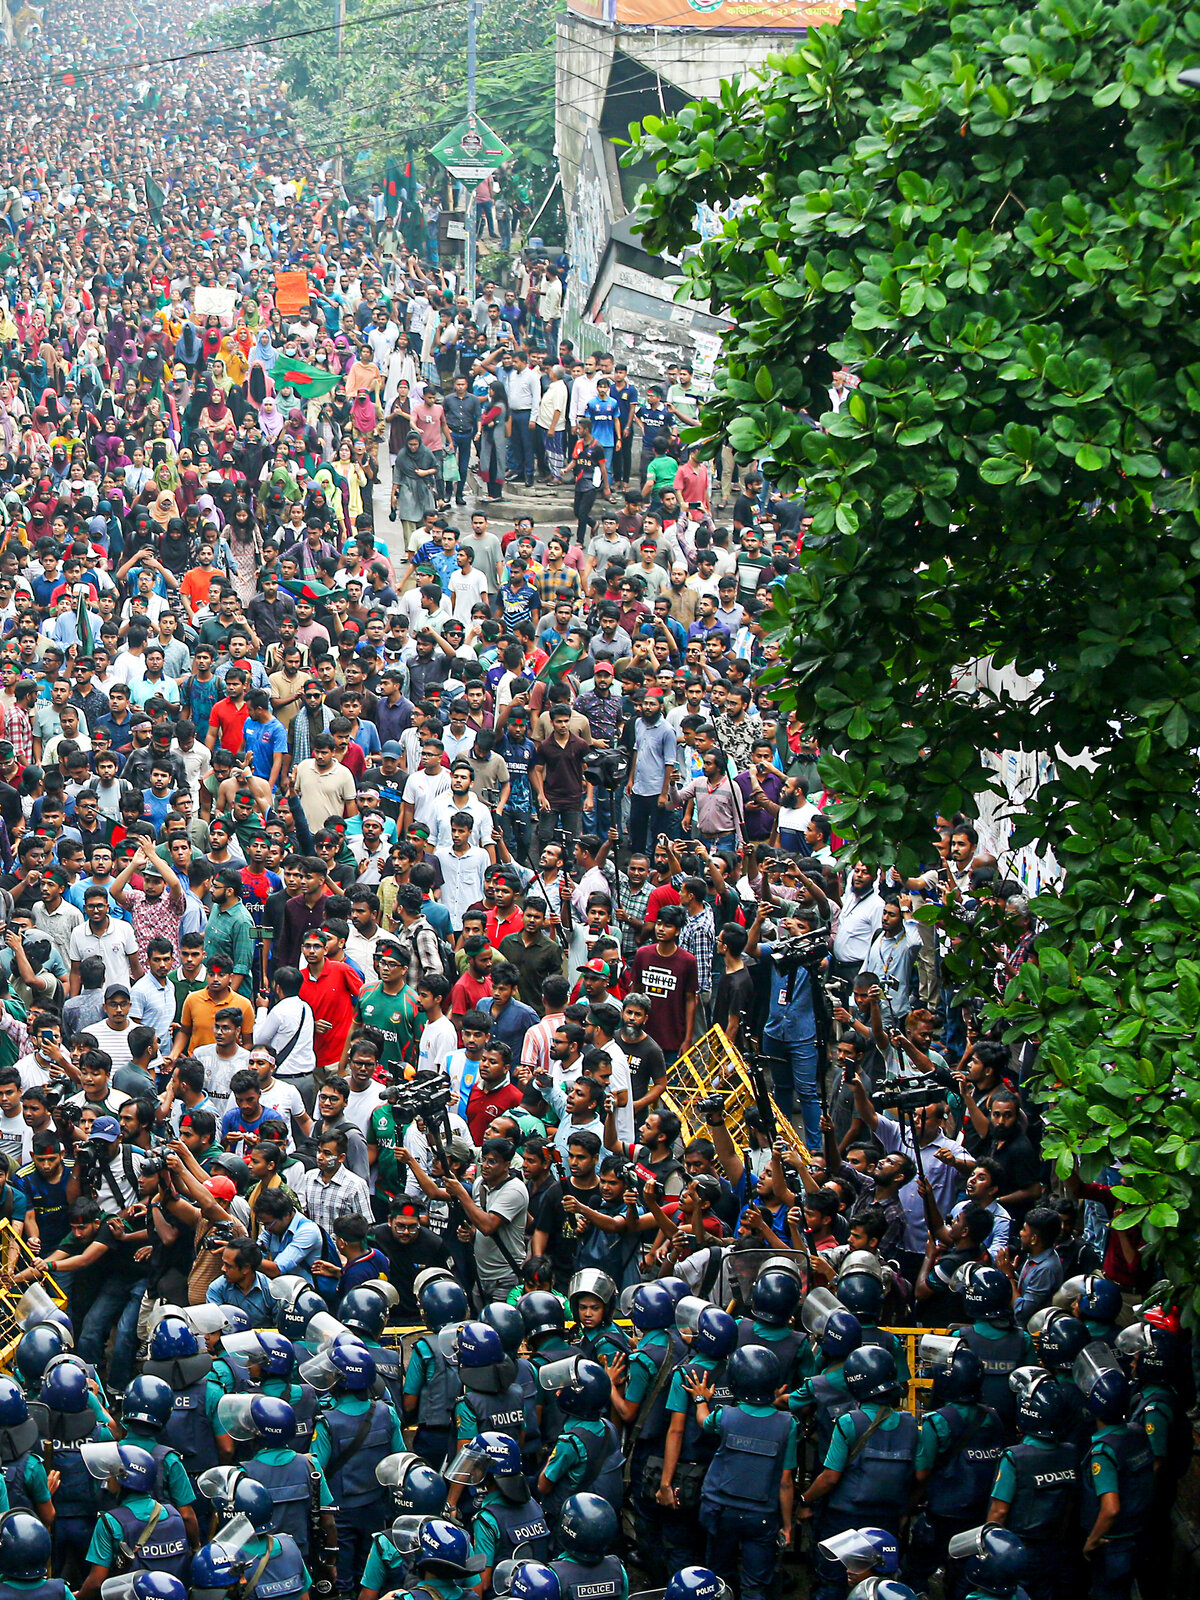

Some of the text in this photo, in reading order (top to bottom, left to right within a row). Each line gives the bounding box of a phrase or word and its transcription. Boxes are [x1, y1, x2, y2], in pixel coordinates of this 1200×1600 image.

[634, 1304, 644, 1312] POLICE
[232, 1316, 247, 1324] POLICE
[286, 1315, 304, 1323] POLICE
[703, 1329, 716, 1340] POLICE
[828, 1329, 842, 1340] POLICE
[462, 1342, 475, 1350] POLICE
[272, 1350, 287, 1359] POLICE
[1144, 1358, 1163, 1367] POLICE
[377, 1364, 399, 1373] POLIC
[848, 1374, 863, 1382] POLICE
[713, 1389, 730, 1397] OLIC
[492, 1410, 524, 1425] POLICE
[1021, 1408, 1038, 1418] POLICE
[486, 1446, 509, 1454] POLICE
[130, 1463, 146, 1473] POLICE
[1034, 1469, 1075, 1486] POLICE
[395, 1499, 413, 1508] POLICE
[514, 1523, 545, 1540] POLICE
[422, 1533, 440, 1549] POLICE
[142, 1542, 184, 1555] POLICE
[213, 1555, 235, 1565] POLICE
[515, 1581, 527, 1592] POLICE
[581, 1585, 611, 1594] POLICE
[696, 1585, 715, 1596] POLICE
